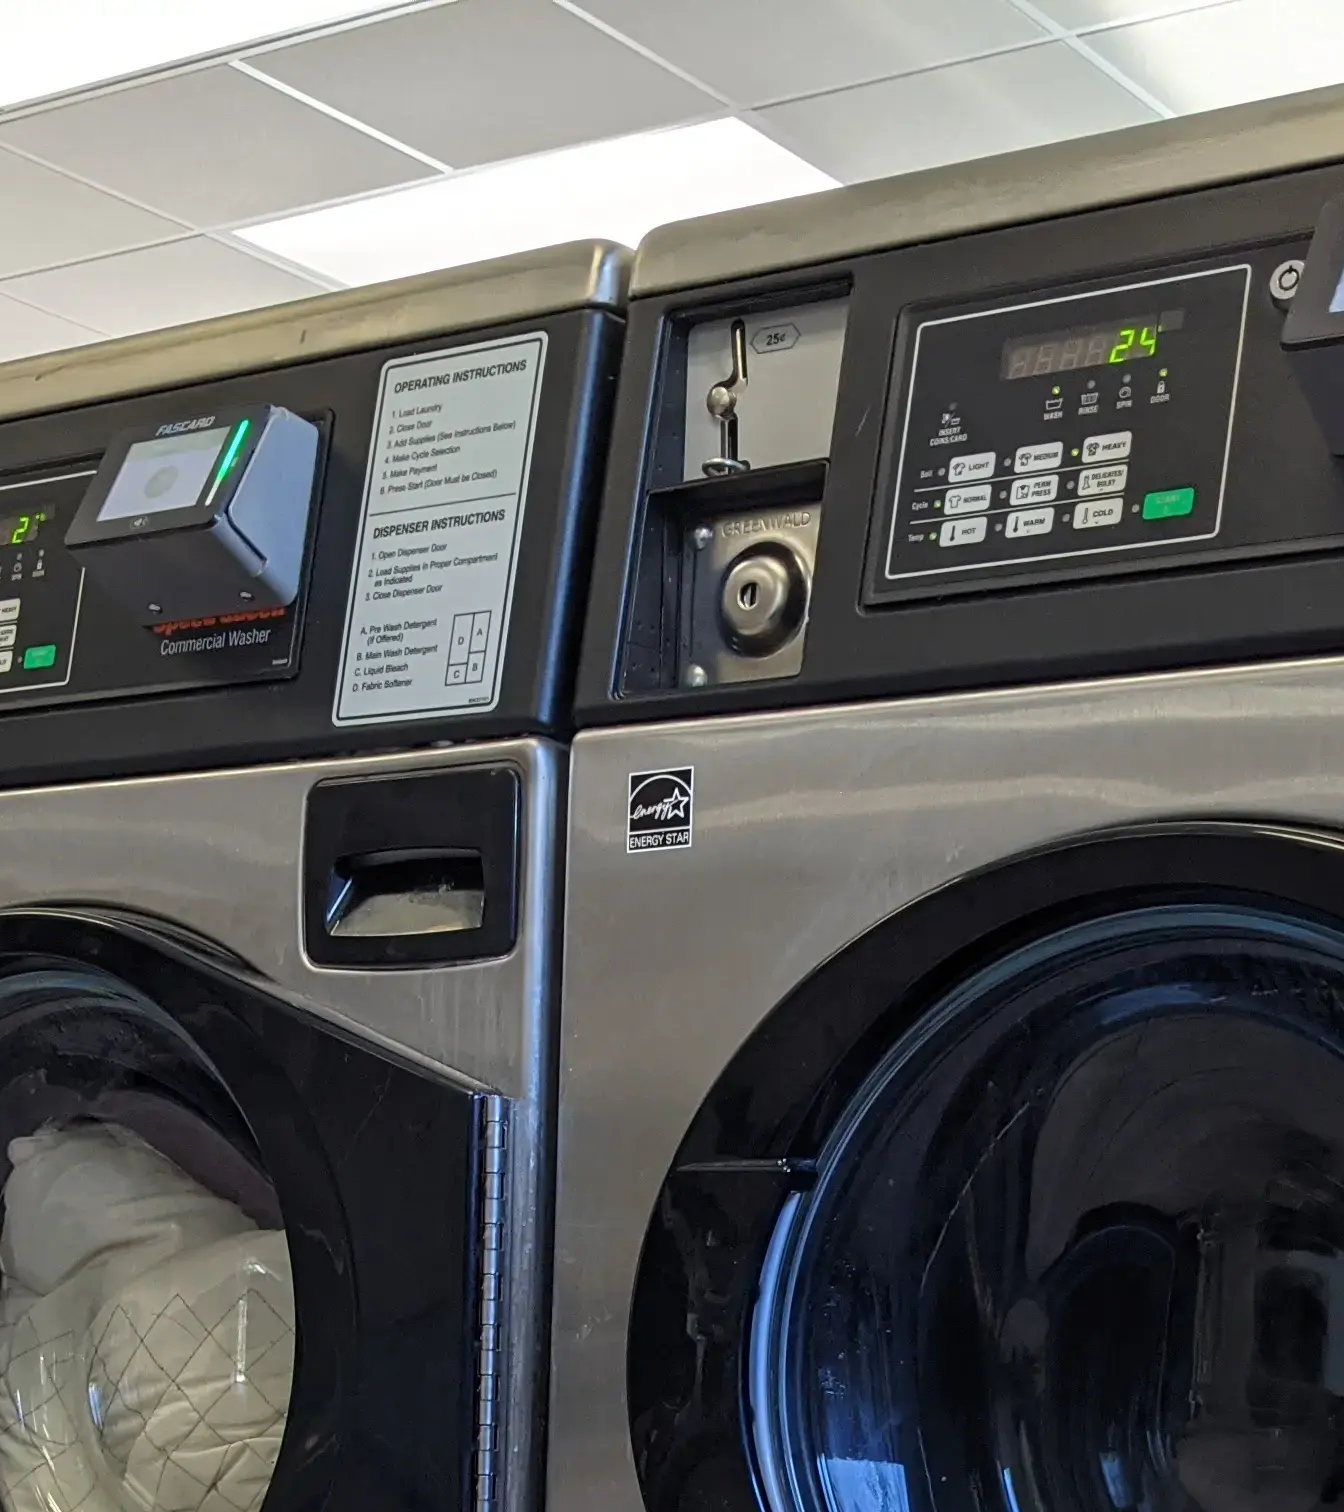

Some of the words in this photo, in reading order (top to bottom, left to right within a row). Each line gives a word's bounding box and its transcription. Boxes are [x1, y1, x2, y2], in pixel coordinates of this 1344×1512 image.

[1108, 327, 1156, 363] 24
[394, 373, 451, 394] OPERATING
[452, 359, 527, 383] INSTRUCTIONS
[398, 408, 415, 418] Load
[415, 404, 442, 415] Laundry
[1102, 441, 1126, 451] HEAVY
[968, 462, 990, 471] LIGHT
[1033, 480, 1052, 489] PERM
[1031, 488, 1051, 497] PRESS
[1092, 508, 1114, 518] COLD
[373, 520, 429, 539] DISPENSER
[430, 508, 506, 531] INSTRUCTIONS
[721, 512, 811, 538] GREENWALD
[1023, 517, 1045, 527] WARM
[961, 527, 977, 536] HOT
[476, 627, 483, 636] A
[160, 632, 226, 656] Commercial
[228, 629, 271, 646] Washer
[457, 636, 465, 646] D
[363, 665, 385, 676] Liquid
[385, 663, 409, 674] Bleach
[471, 662, 478, 672] B
[453, 669, 460, 679] C
[629, 834, 664, 849] ENERGY
[665, 832, 689, 845] STAR
